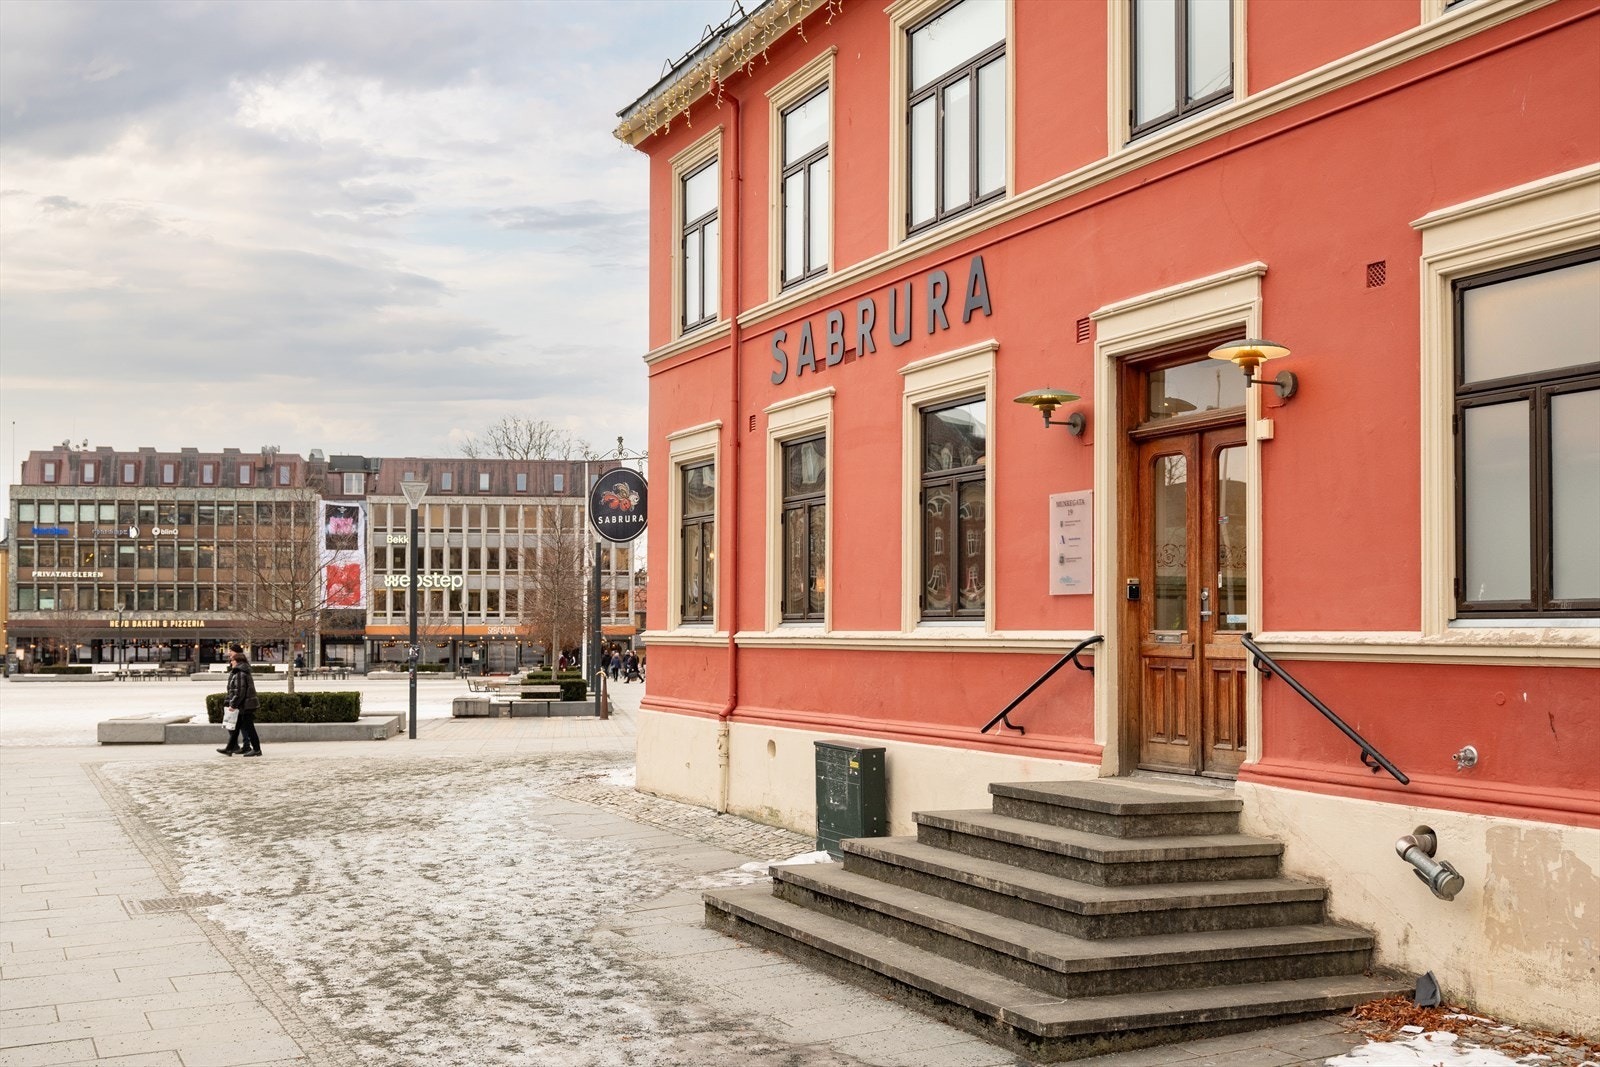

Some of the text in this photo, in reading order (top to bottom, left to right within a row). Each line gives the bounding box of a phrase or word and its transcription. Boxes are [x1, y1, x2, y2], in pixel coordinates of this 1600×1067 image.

[771, 255, 992, 385] SABRURA
[597, 515, 644, 524] SABRURA
[386, 534, 409, 544] Bekk
[31, 571, 104, 579] PRIVATMEGLEREN
[132, 620, 160, 628] BAKERI
[170, 620, 205, 628] PIZZERIA
